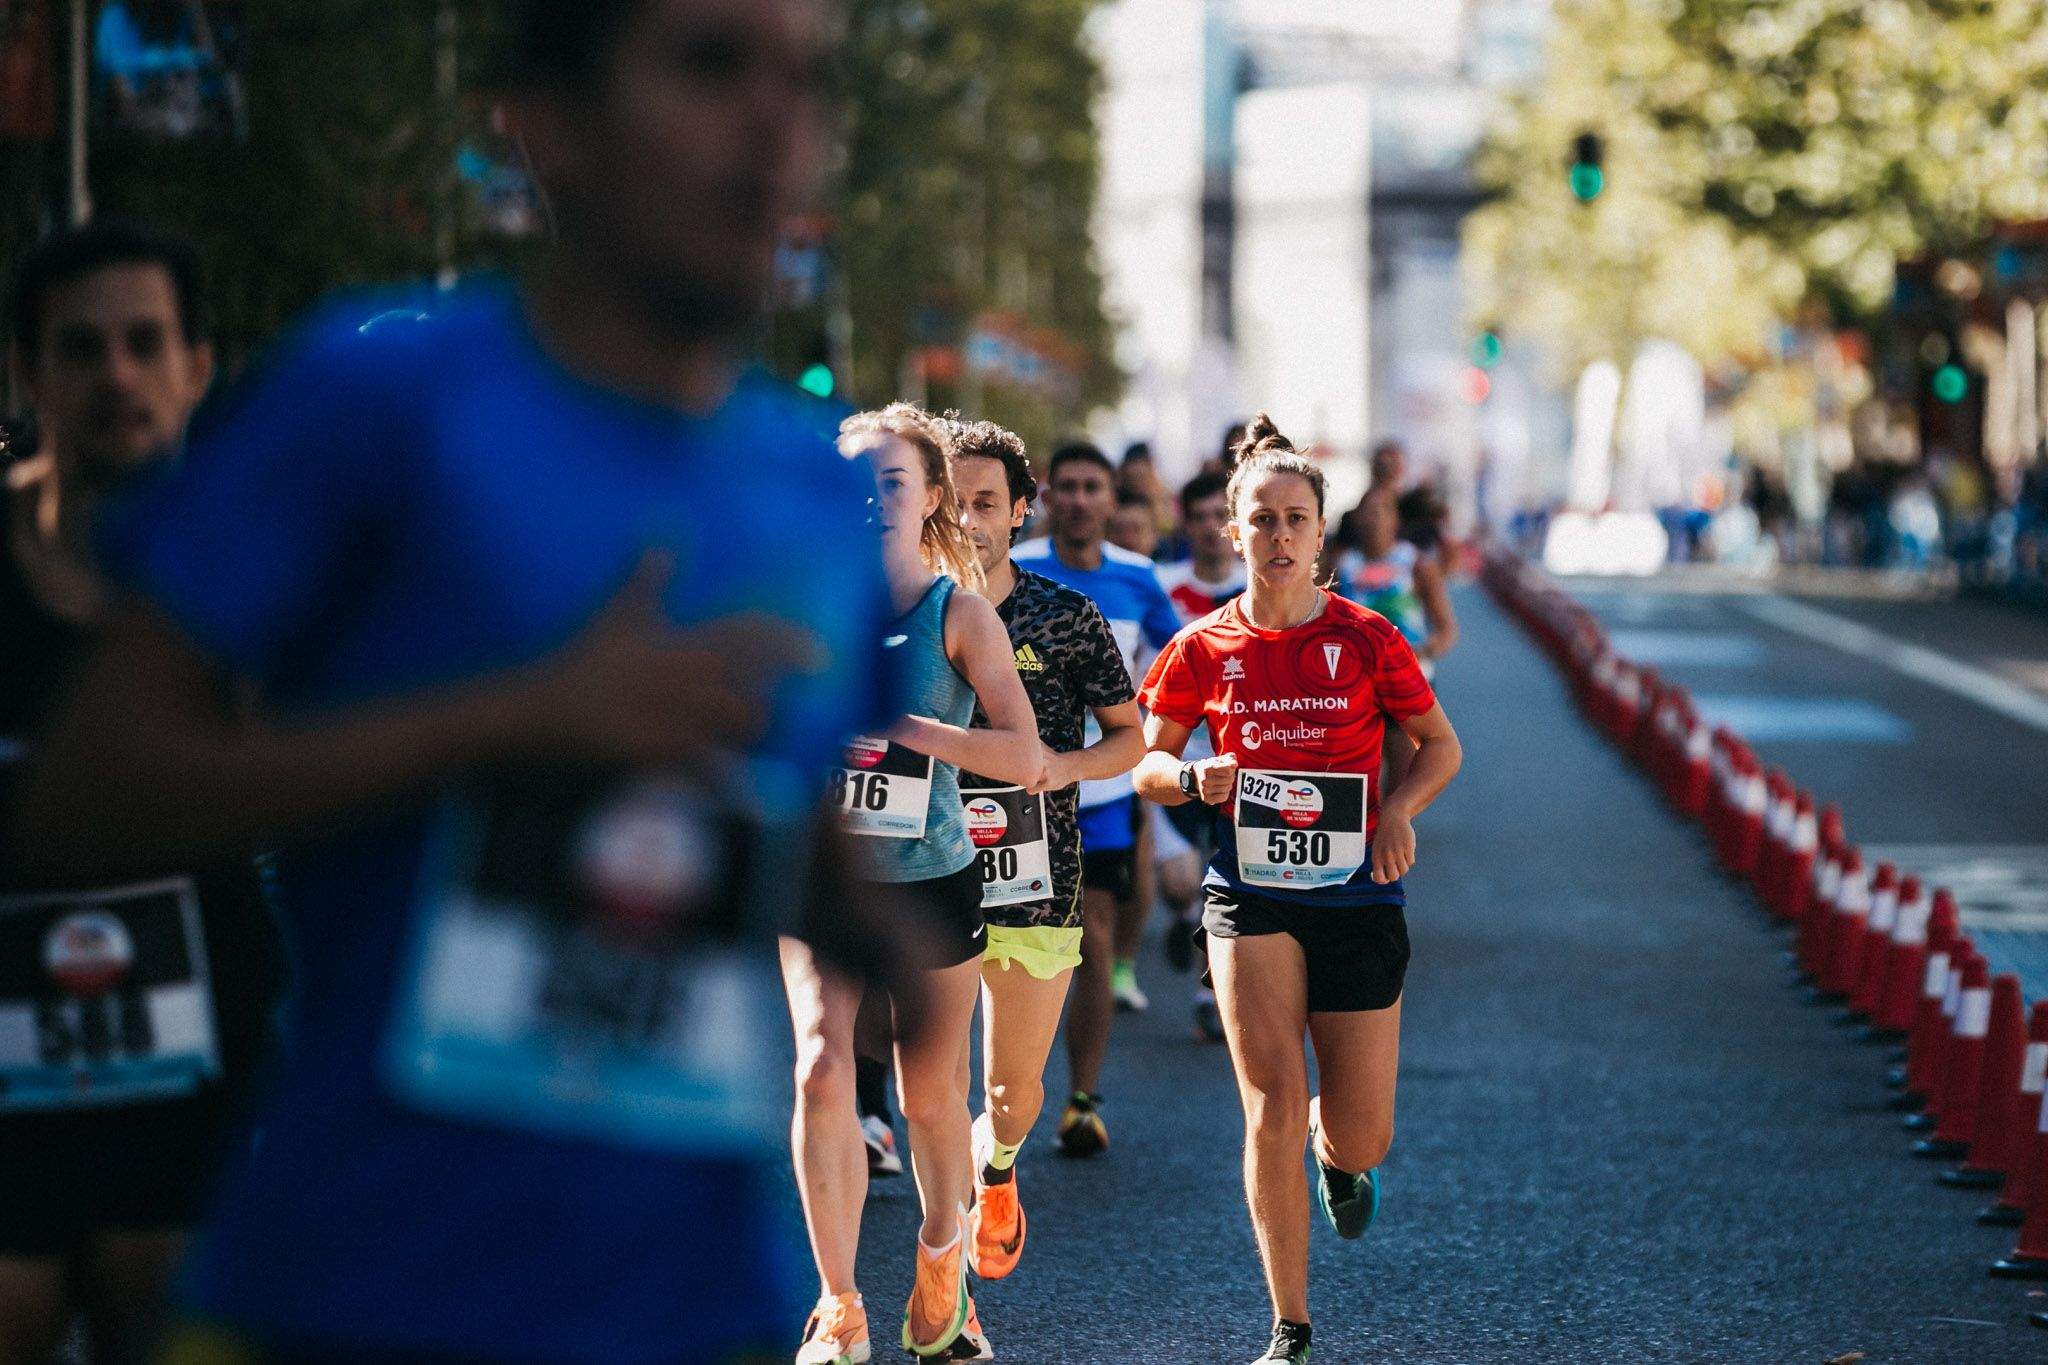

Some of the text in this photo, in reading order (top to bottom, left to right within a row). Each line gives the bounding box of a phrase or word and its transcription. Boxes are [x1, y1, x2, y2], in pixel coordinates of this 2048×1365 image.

[1013, 660, 1043, 671] didas
[1222, 673, 1246, 681] luanvi
[1254, 697, 1348, 713] MARATHON
[1262, 721, 1328, 747] alquiber
[1243, 776, 1281, 803] 3212
[1267, 830, 1330, 866] 530
[1251, 868, 1277, 877] MADRID
